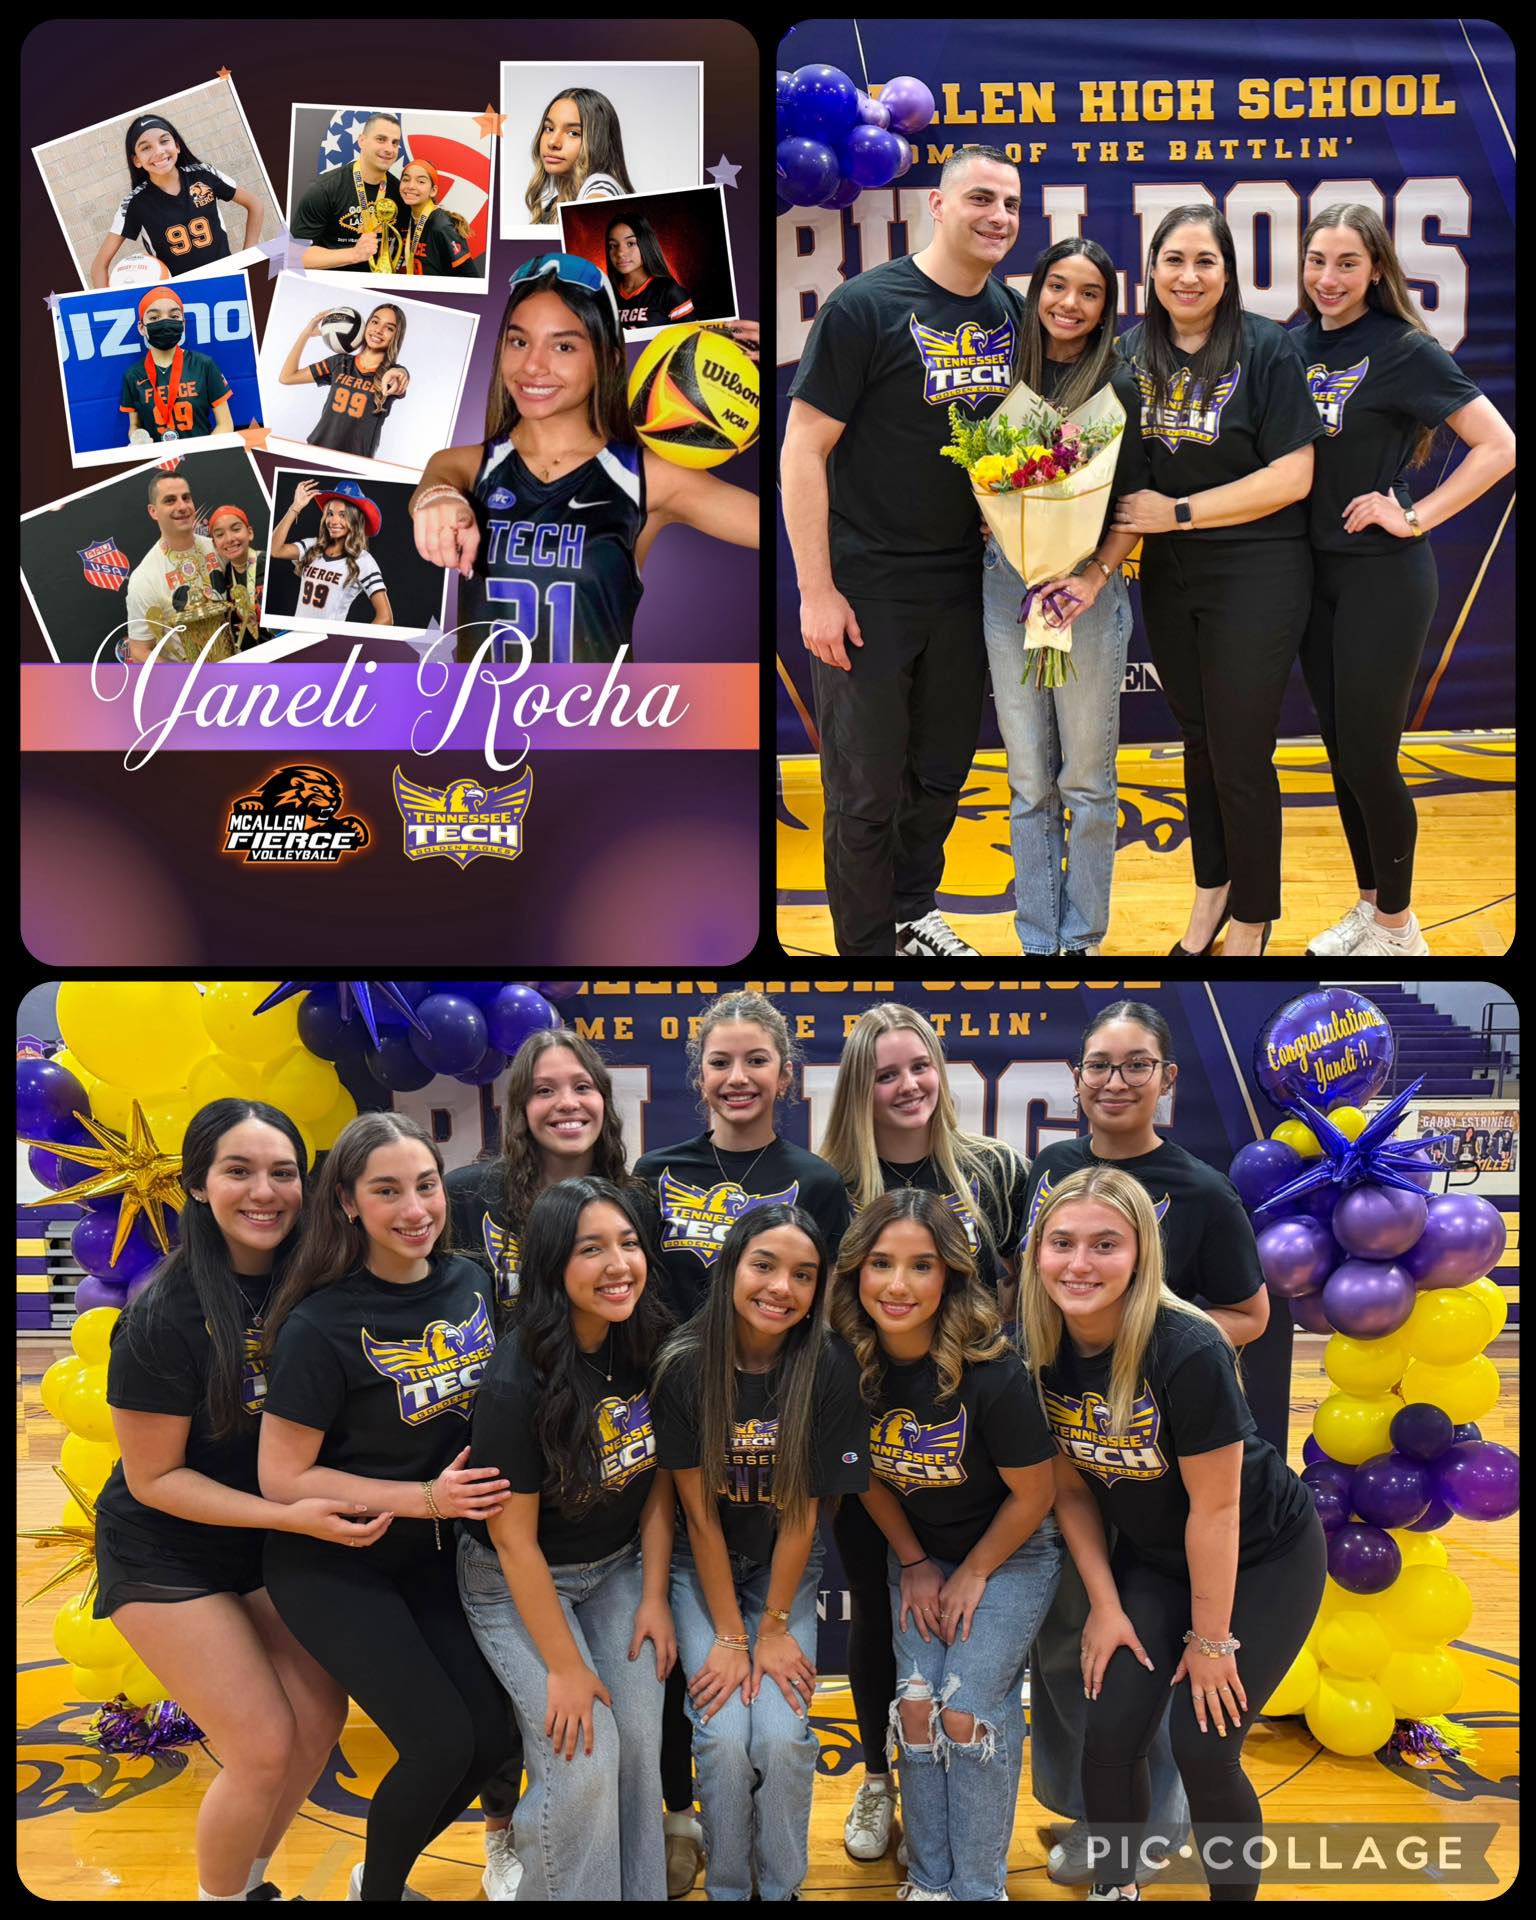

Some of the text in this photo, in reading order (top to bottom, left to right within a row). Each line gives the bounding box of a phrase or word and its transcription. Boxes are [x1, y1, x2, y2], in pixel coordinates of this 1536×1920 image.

[1079, 79, 1215, 123] HIGH
[1238, 74, 1456, 120] SCHOOL
[1005, 142, 1047, 164] OF
[1072, 141, 1145, 163] THE
[1168, 136, 1353, 162] BATTLIN'
[164, 215, 214, 257] 99
[933, 353, 1005, 369] TENNESSEE
[702, 359, 760, 409] Wilson
[929, 365, 1012, 392] TECH
[331, 386, 368, 419] 99
[935, 386, 973, 400] GOLDEN
[152, 400, 195, 434] 99
[721, 408, 750, 431] NCAA
[85, 544, 112, 560] AAU
[487, 519, 586, 569] TECH
[91, 563, 123, 576] USA
[302, 580, 330, 609] 99
[485, 577, 576, 663] 21
[1267, 1007, 1385, 1074] Congratulations
[1314, 1045, 1358, 1094] Yaneli
[1423, 1115, 1514, 1128] GABBY ESTRINGEL
[665, 1217, 732, 1242] TEC
[666, 1240, 711, 1249] GOLDEN
[404, 1346, 493, 1382] TENNESSEE
[403, 1360, 489, 1409] TEC
[731, 1437, 776, 1447] TECH
[870, 1453, 962, 1480] ECH
